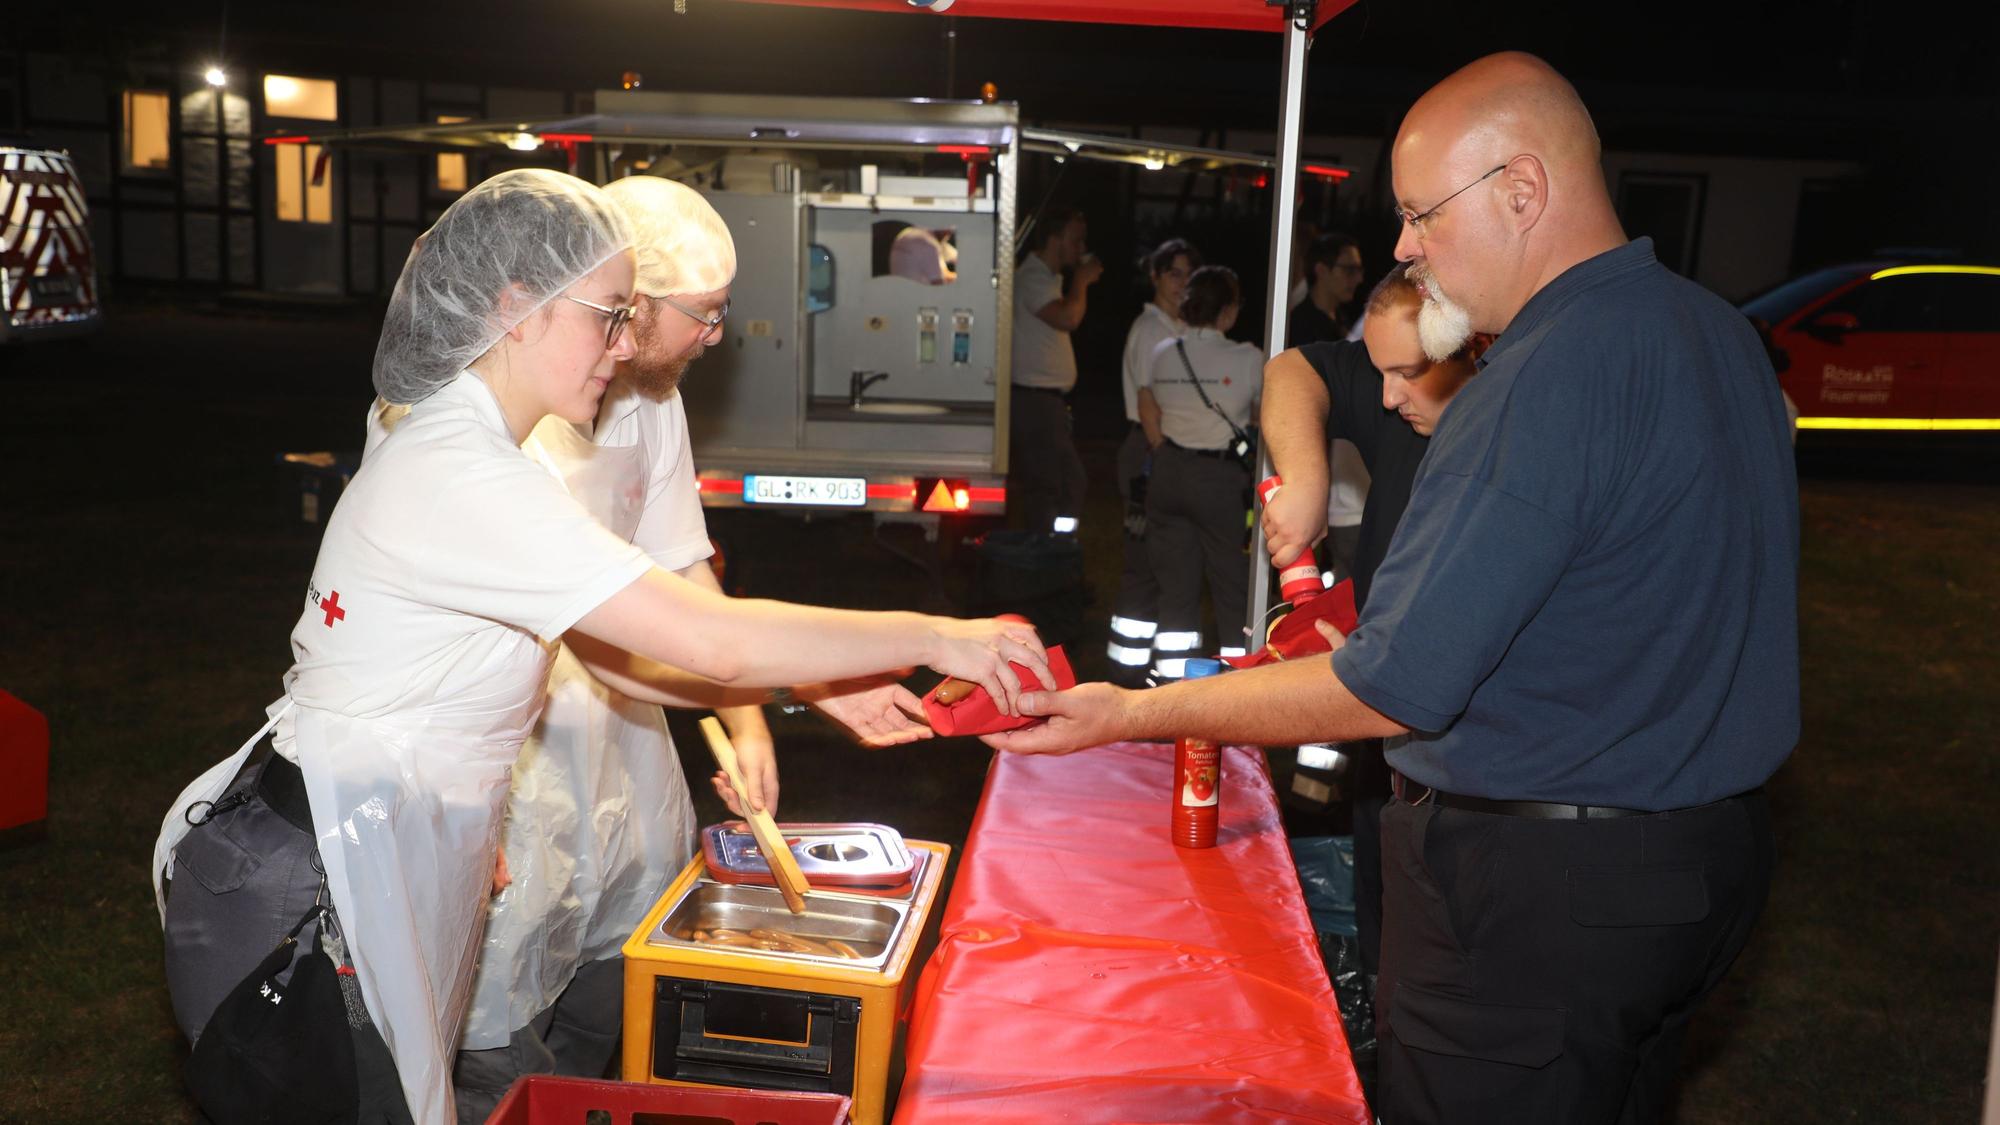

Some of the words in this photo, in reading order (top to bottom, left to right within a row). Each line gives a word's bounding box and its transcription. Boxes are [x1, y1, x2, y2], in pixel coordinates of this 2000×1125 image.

[757, 480, 781, 498] GL
[796, 482, 819, 498] RK
[826, 482, 862, 500] 903
